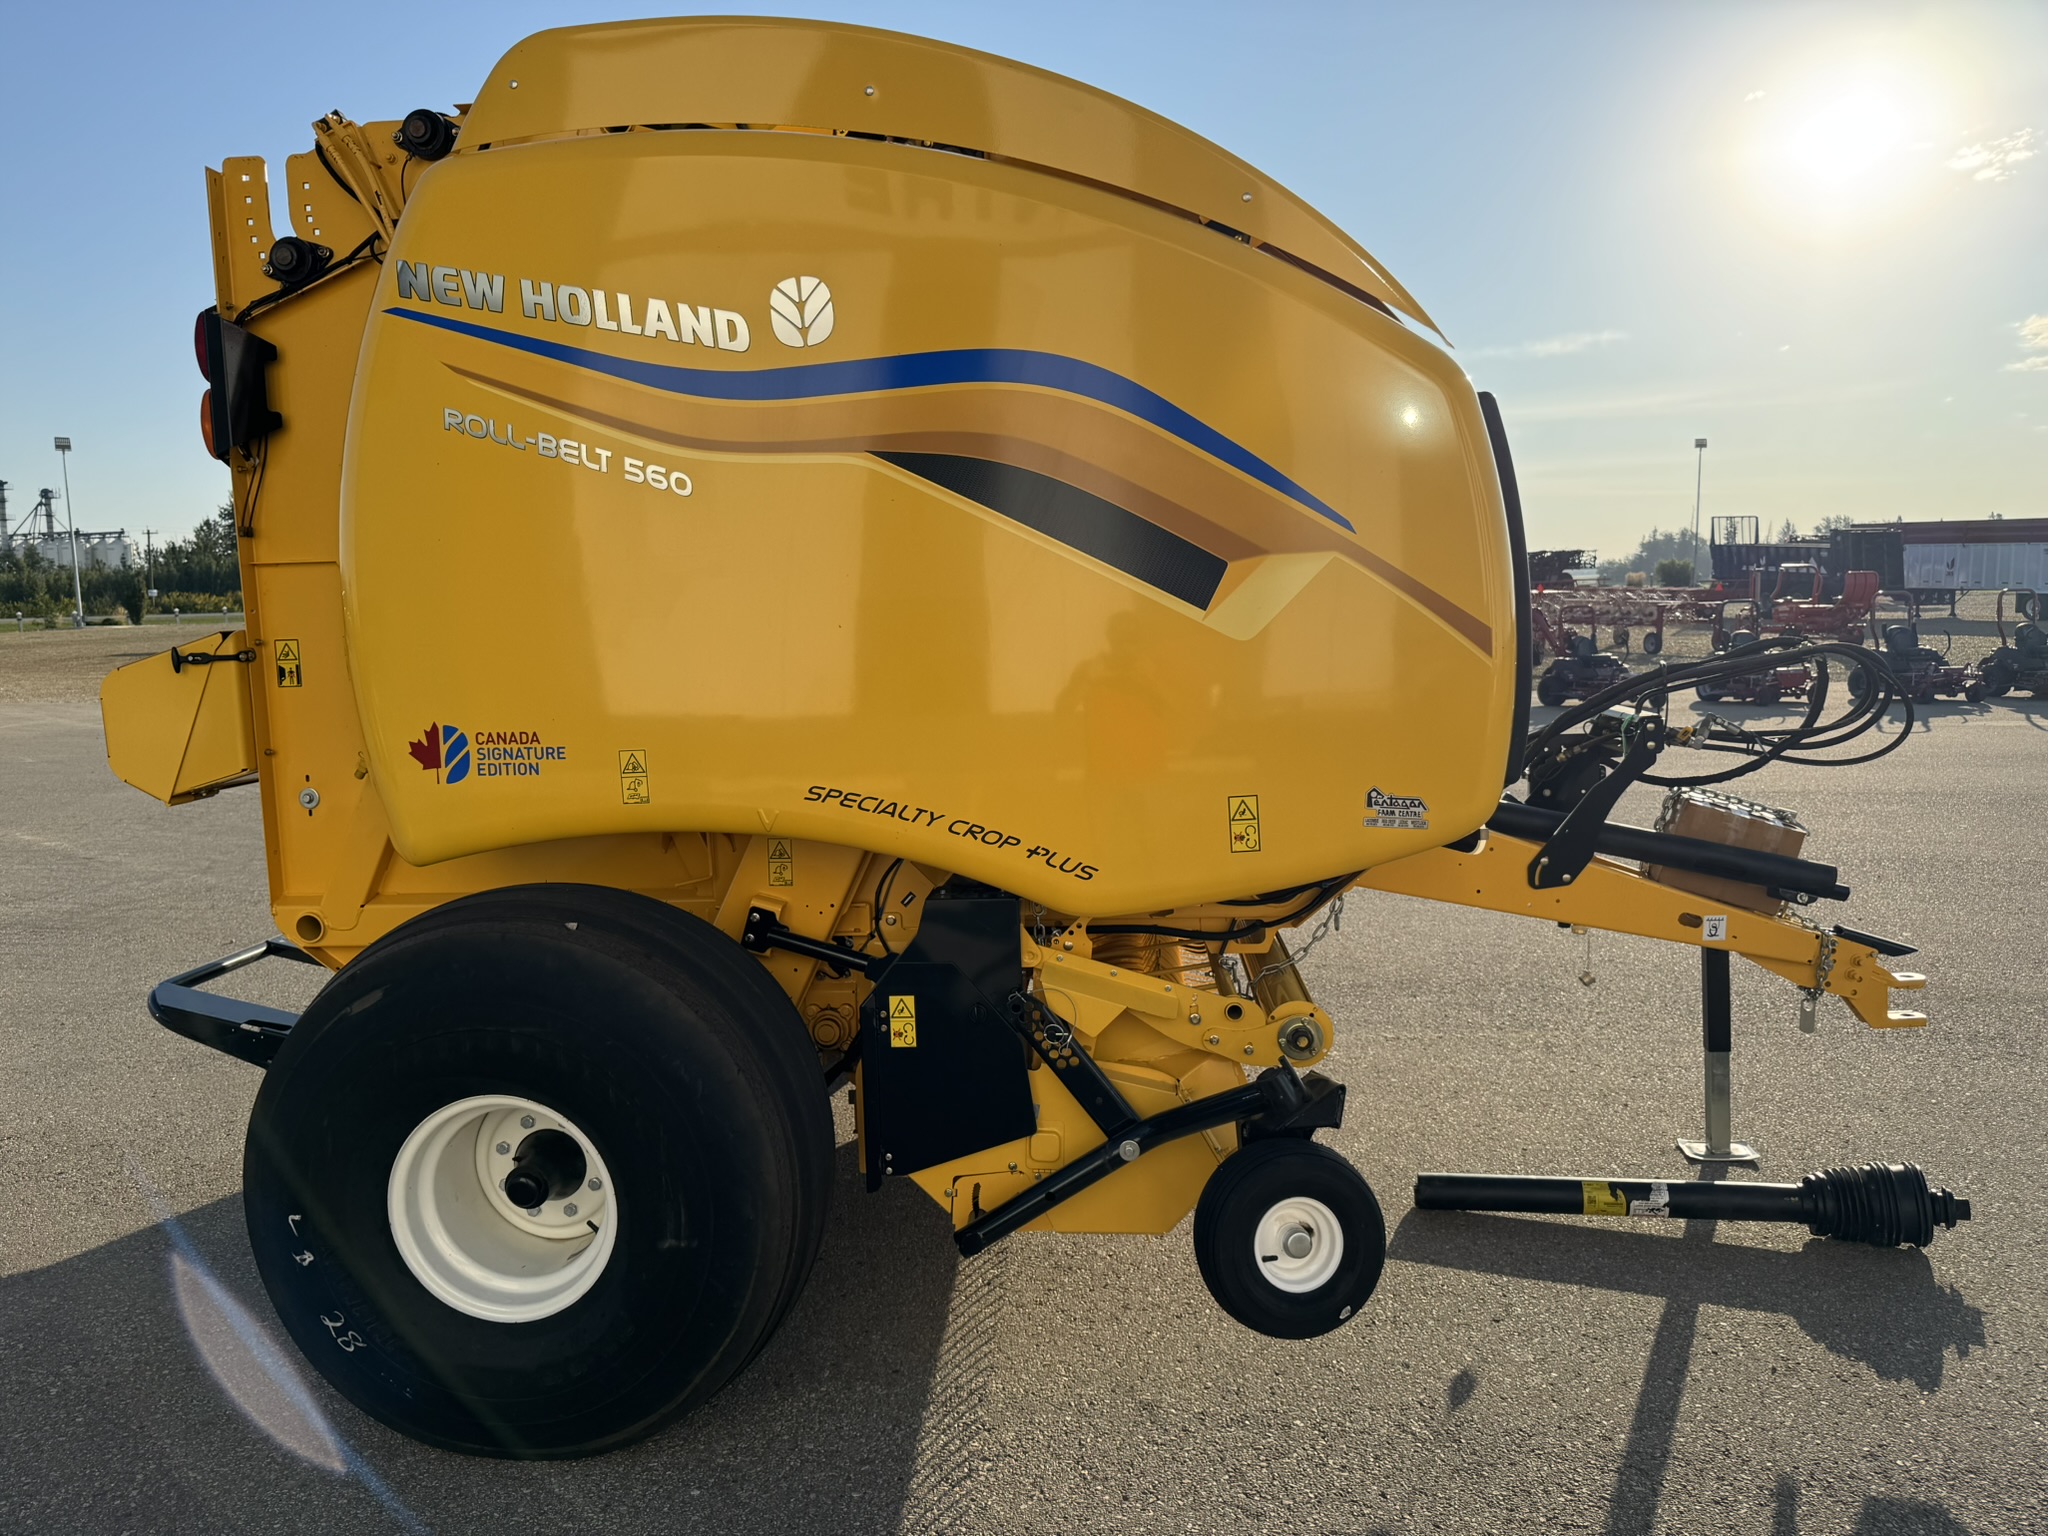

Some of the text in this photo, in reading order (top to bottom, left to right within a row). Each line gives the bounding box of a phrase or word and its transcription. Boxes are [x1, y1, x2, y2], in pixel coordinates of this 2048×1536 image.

[396, 260, 751, 353] NEW HOLLAND
[443, 407, 693, 497] ROLL-BELT 560
[475, 731, 541, 746] CANADA
[476, 746, 567, 761] SIGNATURE
[477, 762, 540, 777] EDITION
[803, 785, 946, 827] SPECIALTY
[948, 819, 1021, 849] CROP
[1377, 809, 1422, 818] FARM CENTRE
[319, 1310, 368, 1352] 28
